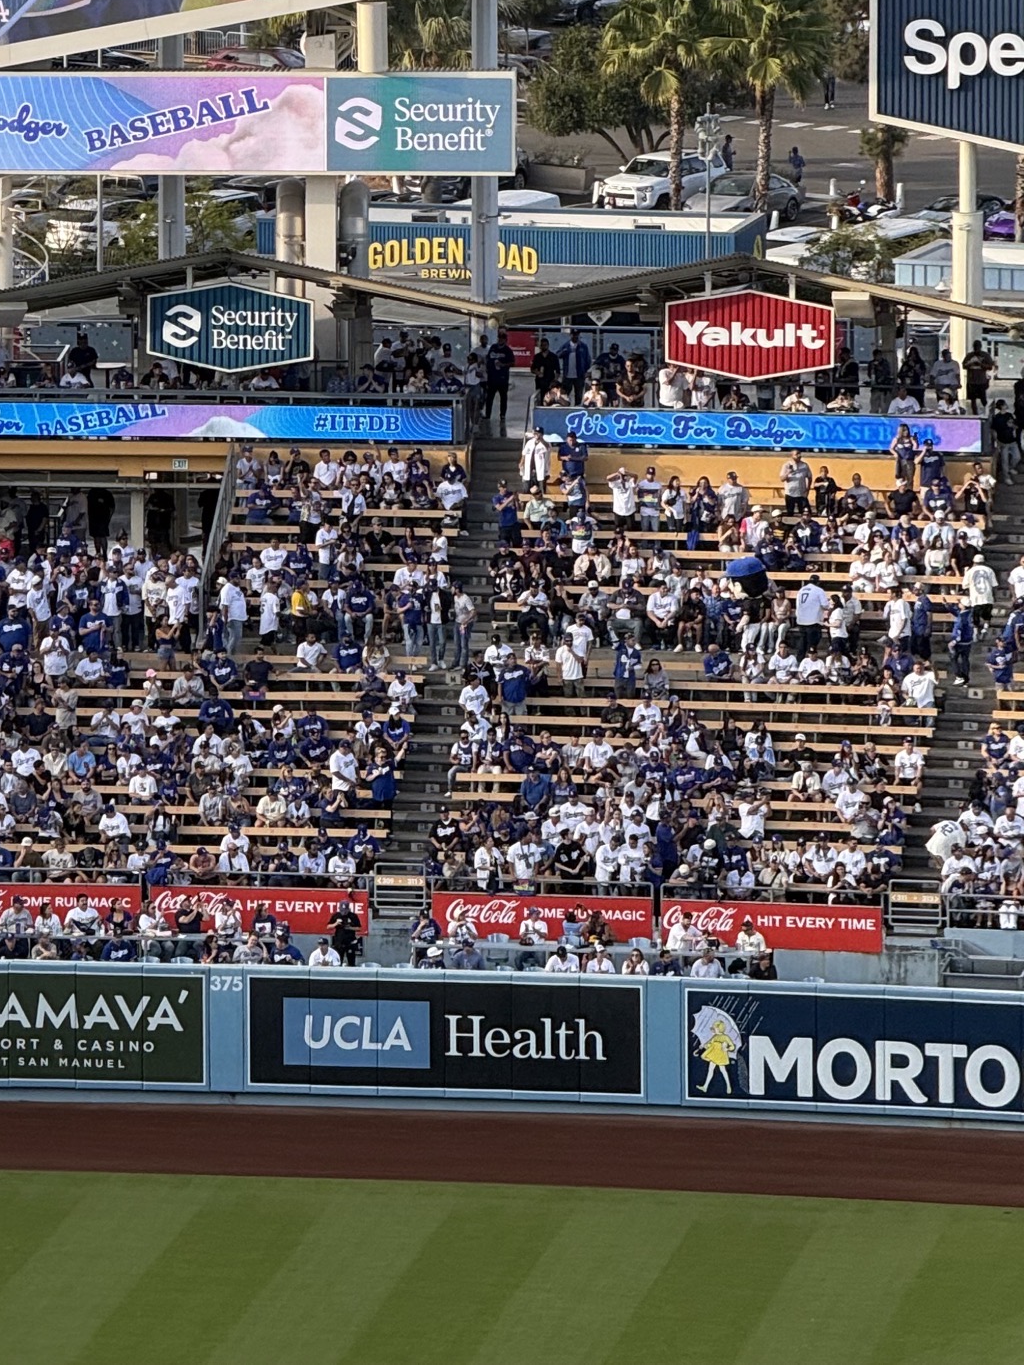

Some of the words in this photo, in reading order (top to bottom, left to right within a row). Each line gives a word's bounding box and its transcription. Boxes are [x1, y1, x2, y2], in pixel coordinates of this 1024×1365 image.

[903, 19, 1024, 90] Spe
[83, 87, 272, 156] BASEBALL
[394, 97, 501, 130] Security
[368, 237, 465, 270] GOLDEN
[496, 241, 538, 275] OAD
[421, 268, 473, 279] BREWIN
[210, 305, 299, 330] Security
[211, 329, 288, 351] Benefit
[674, 319, 826, 351] Yakult
[36, 402, 169, 436] BASEBALL
[313, 412, 402, 433] #ITFDB
[566, 410, 609, 436] It's
[612, 411, 666, 438] Time
[671, 413, 717, 440] For
[725, 413, 806, 446] Dodger
[233, 899, 244, 911] A
[247, 899, 272, 911] HIT
[275, 900, 324, 913] EVERY
[445, 898, 520, 924] Coca-Cola
[601, 909, 646, 921] MAGIC
[757, 915, 782, 927] HIT
[786, 916, 835, 929] EVERY
[837, 917, 876, 930] TIME
[210, 976, 243, 992] 375
[53, 1038, 63, 1051] &
[77, 1039, 155, 1053] CASINO
[302, 1014, 413, 1052] UCLA
[444, 1014, 607, 1061] Health
[17, 1056, 50, 1068] SAN
[59, 1057, 126, 1070] MANUEL
[748, 1035, 1022, 1108] MORTO
